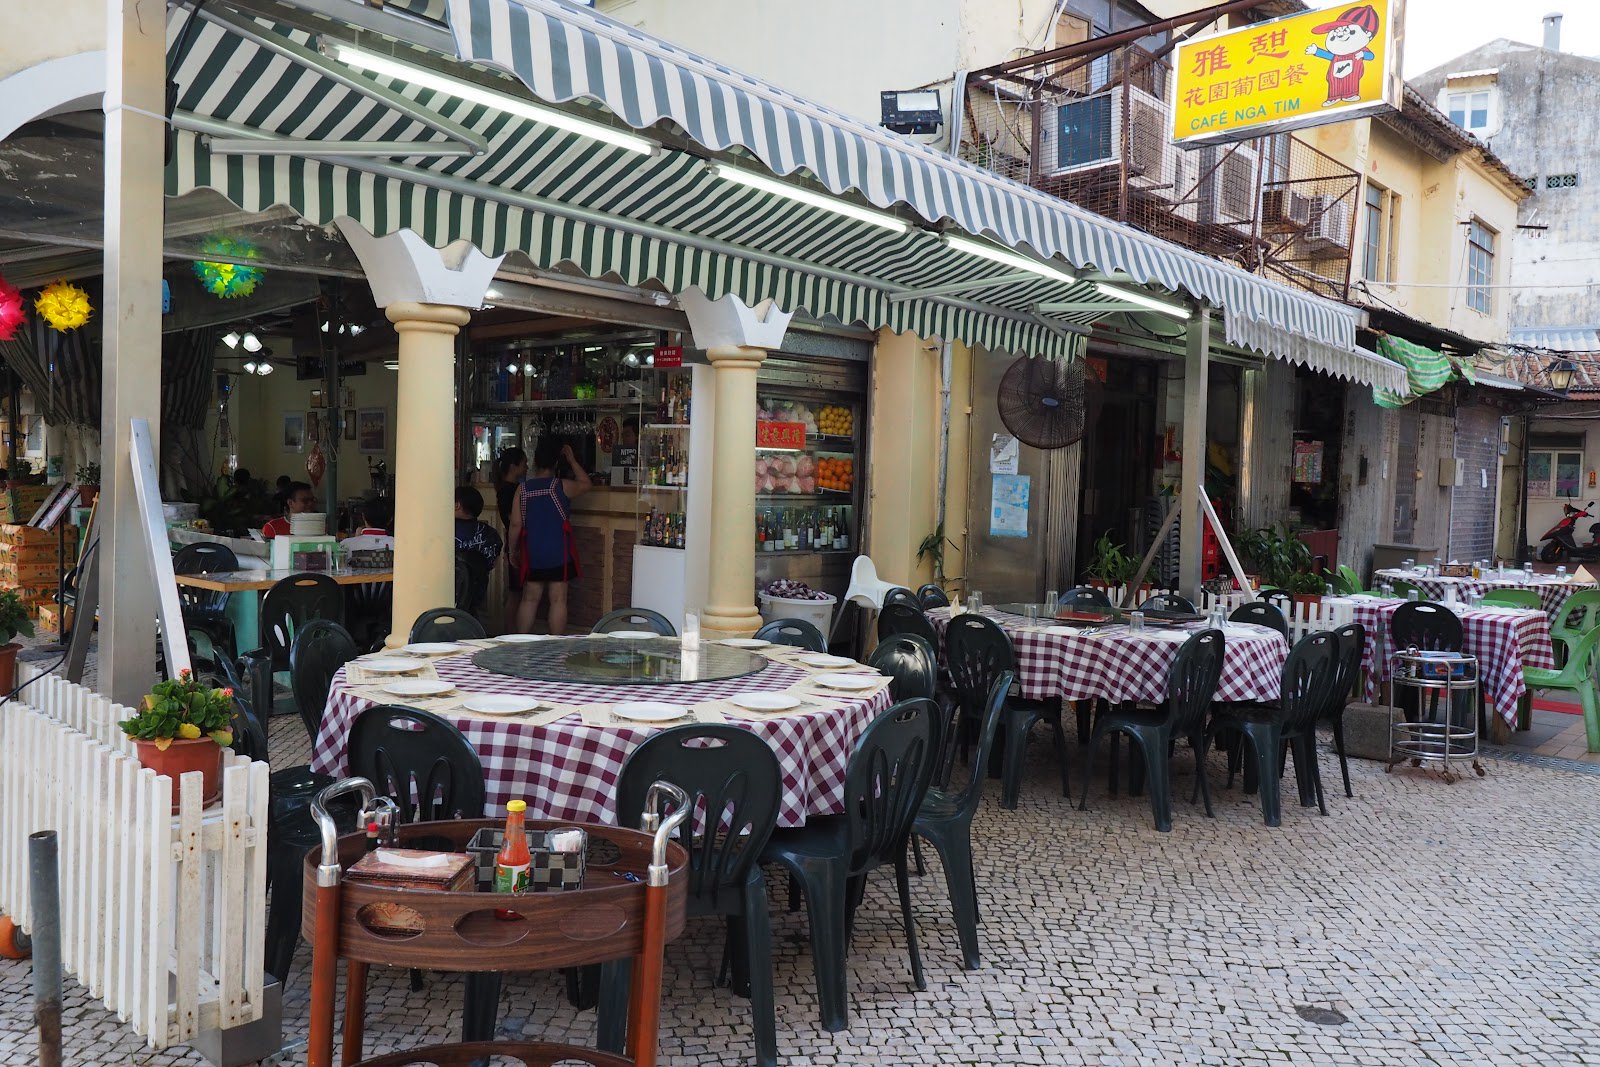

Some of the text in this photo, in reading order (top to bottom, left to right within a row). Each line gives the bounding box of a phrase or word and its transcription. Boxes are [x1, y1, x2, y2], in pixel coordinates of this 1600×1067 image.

[1183, 63, 1309, 108] 花園葡國餐
[1190, 97, 1301, 131] CAFÉ NGA TIM
